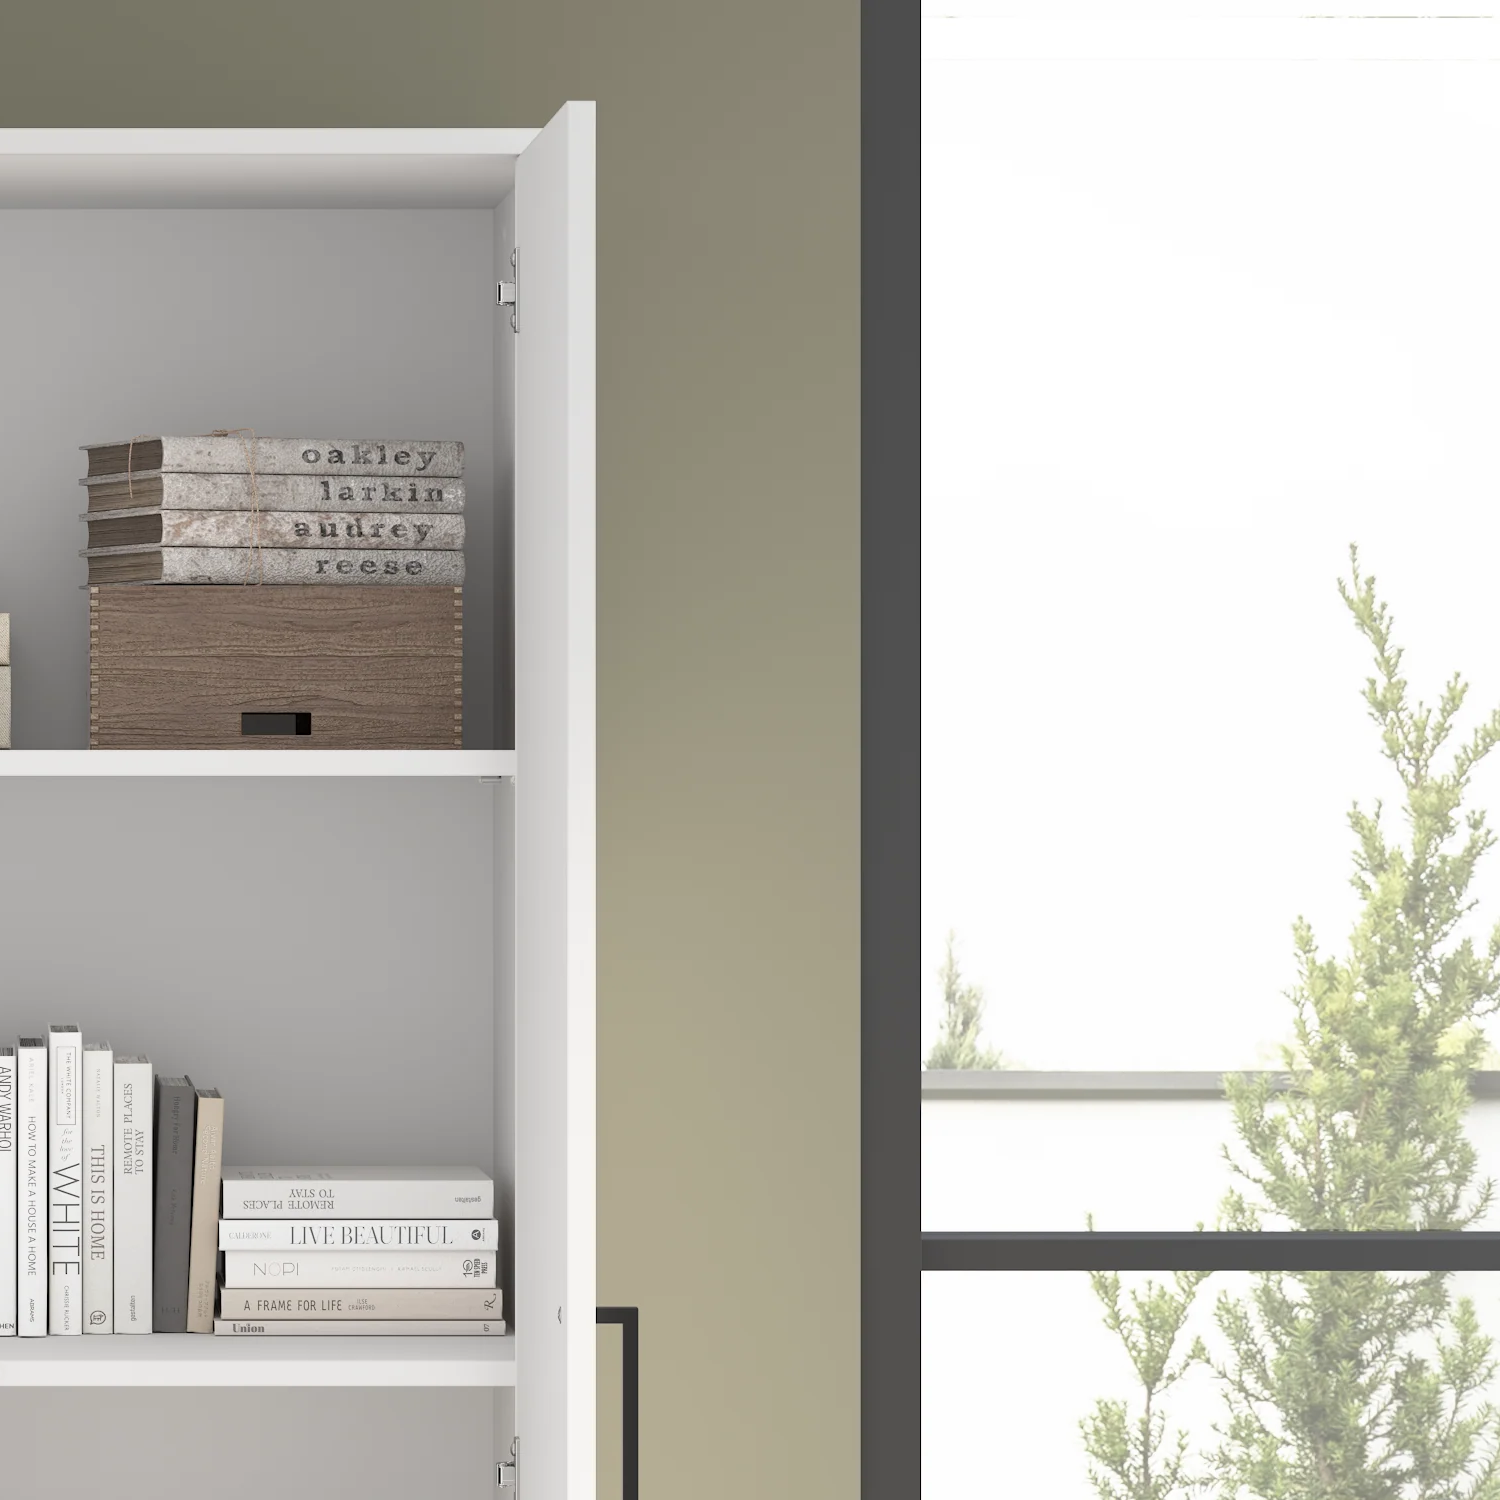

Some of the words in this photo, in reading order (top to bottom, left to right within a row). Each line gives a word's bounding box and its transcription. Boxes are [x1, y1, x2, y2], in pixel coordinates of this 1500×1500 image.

[301, 444, 437, 471] oakley
[320, 481, 444, 502] larkin
[294, 517, 434, 542] audrey
[316, 557, 424, 576] reese
[123, 1083, 133, 1123] PLACES
[28, 1116, 36, 1141] HOW
[28, 1144, 36, 1157] TO
[123, 1128, 133, 1175] REMOTE
[135, 1129, 143, 1155] STAY
[28, 1160, 36, 1187] MAKE
[91, 1145, 105, 1184] THIS
[135, 1159, 143, 1175] TO
[91, 1190, 105, 1204] IS
[289, 1189, 315, 1198] STAY
[319, 1189, 334, 1198] TO
[243, 1200, 283, 1209] PLACES
[288, 1200, 334, 1209] REMOTE
[28, 1200, 36, 1234] HOUSE
[52, 1163, 80, 1275] WHITE
[91, 1210, 105, 1261] HOME
[291, 1226, 335, 1244] LIVE
[341, 1226, 453, 1244] BEAUTIFUL
[28, 1246, 36, 1275] HOME
[253, 1262, 299, 1276] NOPI
[244, 1300, 251, 1311] A
[257, 1300, 292, 1312] FRAME
[297, 1300, 317, 1311] FOR
[321, 1300, 342, 1311] LIFE
[232, 1323, 265, 1333] Union
